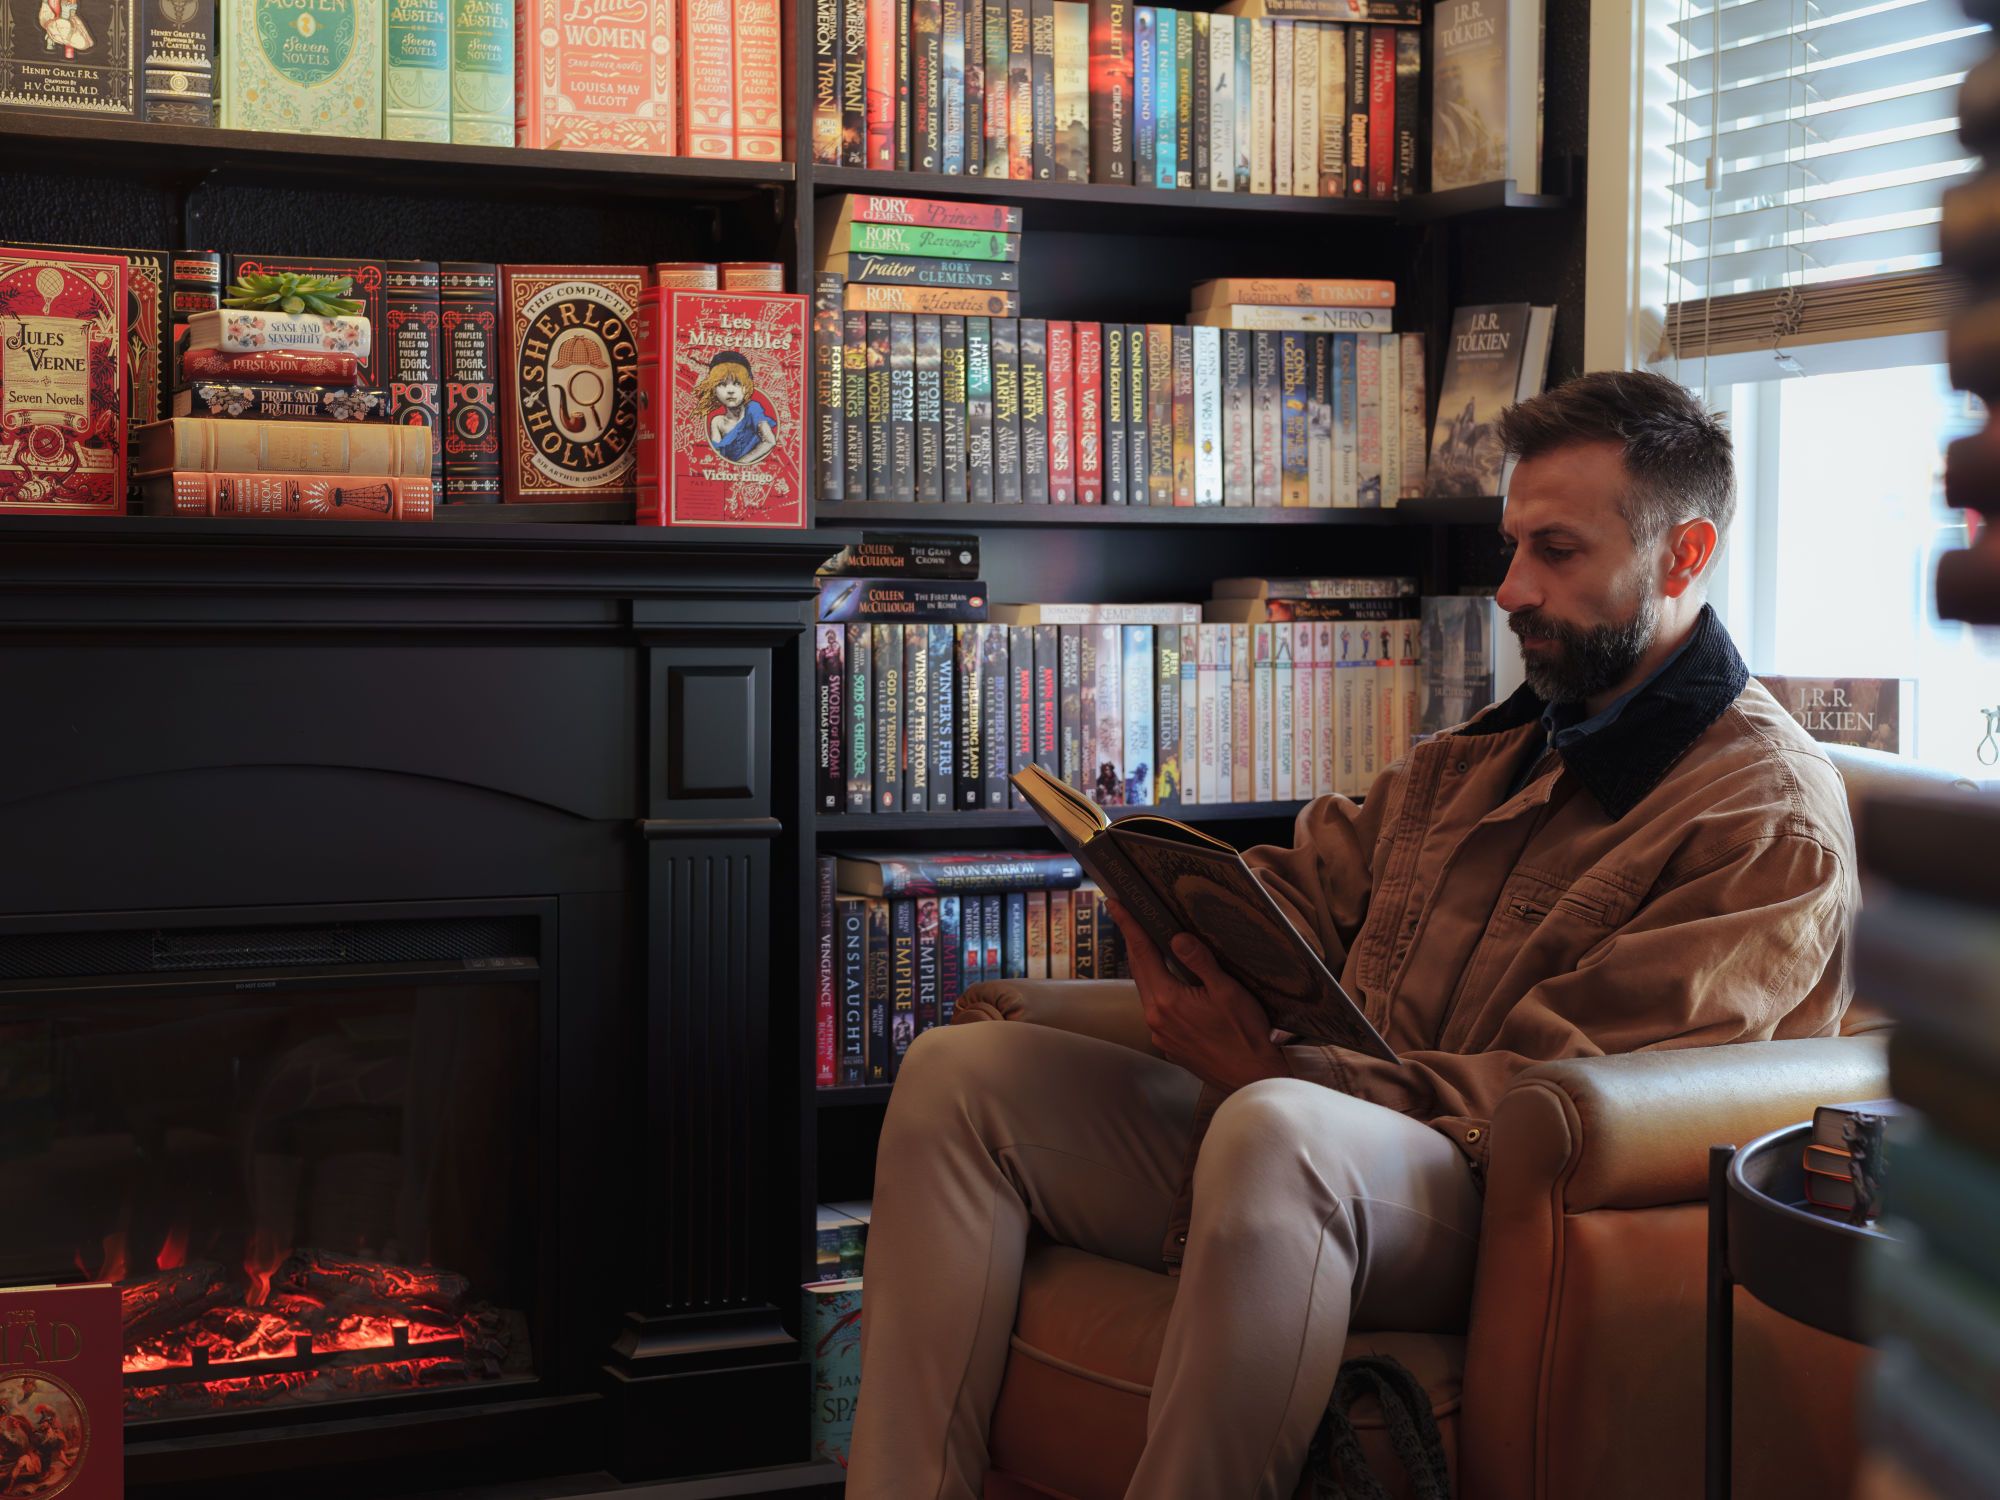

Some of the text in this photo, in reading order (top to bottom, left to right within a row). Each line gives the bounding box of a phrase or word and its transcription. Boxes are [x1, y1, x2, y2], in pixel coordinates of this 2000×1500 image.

[390, 9, 445, 24] AUSTEN
[456, 12, 509, 29] AUSTEN
[464, 1, 504, 15] JANE
[691, 1, 731, 23] Little
[151, 29, 172, 37] HENRY
[402, 33, 436, 47] Seven
[563, 25, 646, 49] WOMEN
[692, 23, 729, 35] WOMEN
[739, 25, 777, 37] WOMEN
[1011, 9, 1023, 53] FABBRI
[1043, 16, 1053, 57] ROBERT
[1441, 18, 1495, 48] TOLKIEN
[282, 52, 330, 66] NOVELS
[284, 36, 328, 53] Seven
[401, 46, 437, 57] NOVELS
[467, 50, 502, 62] NOVELS
[22, 66, 50, 76] HENRY
[697, 68, 726, 77] LOUISA
[818, 58, 837, 113] TYRANT
[918, 70, 927, 97] EMPTY
[1110, 3, 1124, 152] FOLLETT CIRCLE DAYS
[1141, 40, 1150, 120] OATH BOUND
[1160, 22, 1169, 129] THE ENCIRCLING
[1374, 39, 1385, 103] HOLLAND
[571, 81, 640, 95] LOUISA MAY
[584, 95, 628, 106] ALCOTT
[698, 84, 727, 94] ALCOTT
[845, 60, 865, 116] TYRANT
[928, 112, 938, 151] LEGACY
[1180, 128, 1188, 160] SPEAR
[1213, 103, 1223, 163] GILMAN
[1300, 95, 1311, 172] DEMELZA
[869, 197, 909, 214] RORY
[865, 227, 906, 241] RORY
[919, 231, 981, 255] Revenger
[858, 254, 993, 286] Traitor CLEMENTS
[527, 286, 629, 316] THE COMPLETE
[1318, 285, 1374, 300] TYRANT
[271, 323, 295, 332] SENSE
[721, 313, 752, 330] Les
[1324, 311, 1374, 329] NERO
[1469, 313, 1500, 335] J.R.R.
[6, 323, 64, 349] JULES
[268, 333, 321, 345] SENSIBILITY
[523, 303, 638, 383] SHERLOCK
[688, 329, 791, 350] Misérables
[1456, 331, 1511, 352] TOLKIEN
[26, 348, 86, 371] VERNE
[233, 358, 298, 374] PERSUASION
[400, 359, 431, 369] EDGAR
[456, 359, 486, 369] EDGAR
[1149, 331, 1160, 391] IGGULDEN
[1179, 337, 1191, 395] EMPEROR
[398, 371, 428, 381] ALLAN
[454, 371, 484, 381] ALLAN
[819, 371, 831, 408] FURY
[832, 345, 842, 408] FORTRESS
[9, 391, 84, 405] Seven Novels
[261, 389, 319, 403] PRIDE AND
[261, 403, 318, 416] PREJUDICE
[390, 383, 439, 414] POE
[446, 383, 495, 413] POE
[846, 374, 857, 418] KINGS
[869, 371, 881, 422] WODEN
[892, 370, 901, 422] OF STEEL
[902, 370, 913, 421] STORM
[928, 371, 940, 422] STORM
[1110, 330, 1123, 484] CONN IGGULDEN Protector
[1131, 331, 1145, 484] CONN IGGULDEN Protector
[528, 408, 636, 468] HOLMES
[823, 415, 832, 464] HARFFY
[945, 408, 956, 472] HARFFY
[970, 434, 981, 468] FOES
[981, 426, 991, 465] FOREST
[997, 427, 1008, 474] SWORDS
[1152, 418, 1161, 476] THE PLAINS
[1161, 424, 1170, 470] WOLF OF
[550, 467, 581, 482] ARTHUR
[702, 469, 774, 484] Victor Hugo
[273, 481, 282, 512] TESLA
[858, 545, 895, 555] COLLEEN
[910, 547, 951, 556] THE GRASS
[916, 556, 945, 565] CROWN
[869, 590, 904, 601] COLLEEN
[931, 593, 949, 602] FIRST
[1161, 649, 1170, 678] KANE
[1170, 652, 1178, 675] BEN
[1221, 685, 1229, 733] FLASHMAN
[1282, 685, 1290, 729] FLASH FOR
[1800, 688, 1852, 708] J.R.R.
[821, 685, 829, 768] DOUGLAS JACKSON
[829, 675, 840, 779] SWORD ROME
[887, 669, 897, 783] GOD VENGEANCE
[914, 649, 926, 788] WINGS OF THE STORM
[939, 660, 951, 776] WINTER'S FIRE
[1161, 684, 1171, 750] REBELLION
[1302, 671, 1311, 785] FLASHMAN GREAT GAME
[1792, 712, 1875, 732] OLKIEN
[943, 862, 1035, 877] SIMON SCARROW
[1030, 911, 1040, 957] KNIVES
[821, 934, 831, 1008] VENGEANCE
[895, 937, 911, 1011] EMPIRE
[920, 937, 935, 1004] EMPIRE
[846, 917, 860, 1055] ONSLAUGHT
[0, 1322, 81, 1365] IAD
